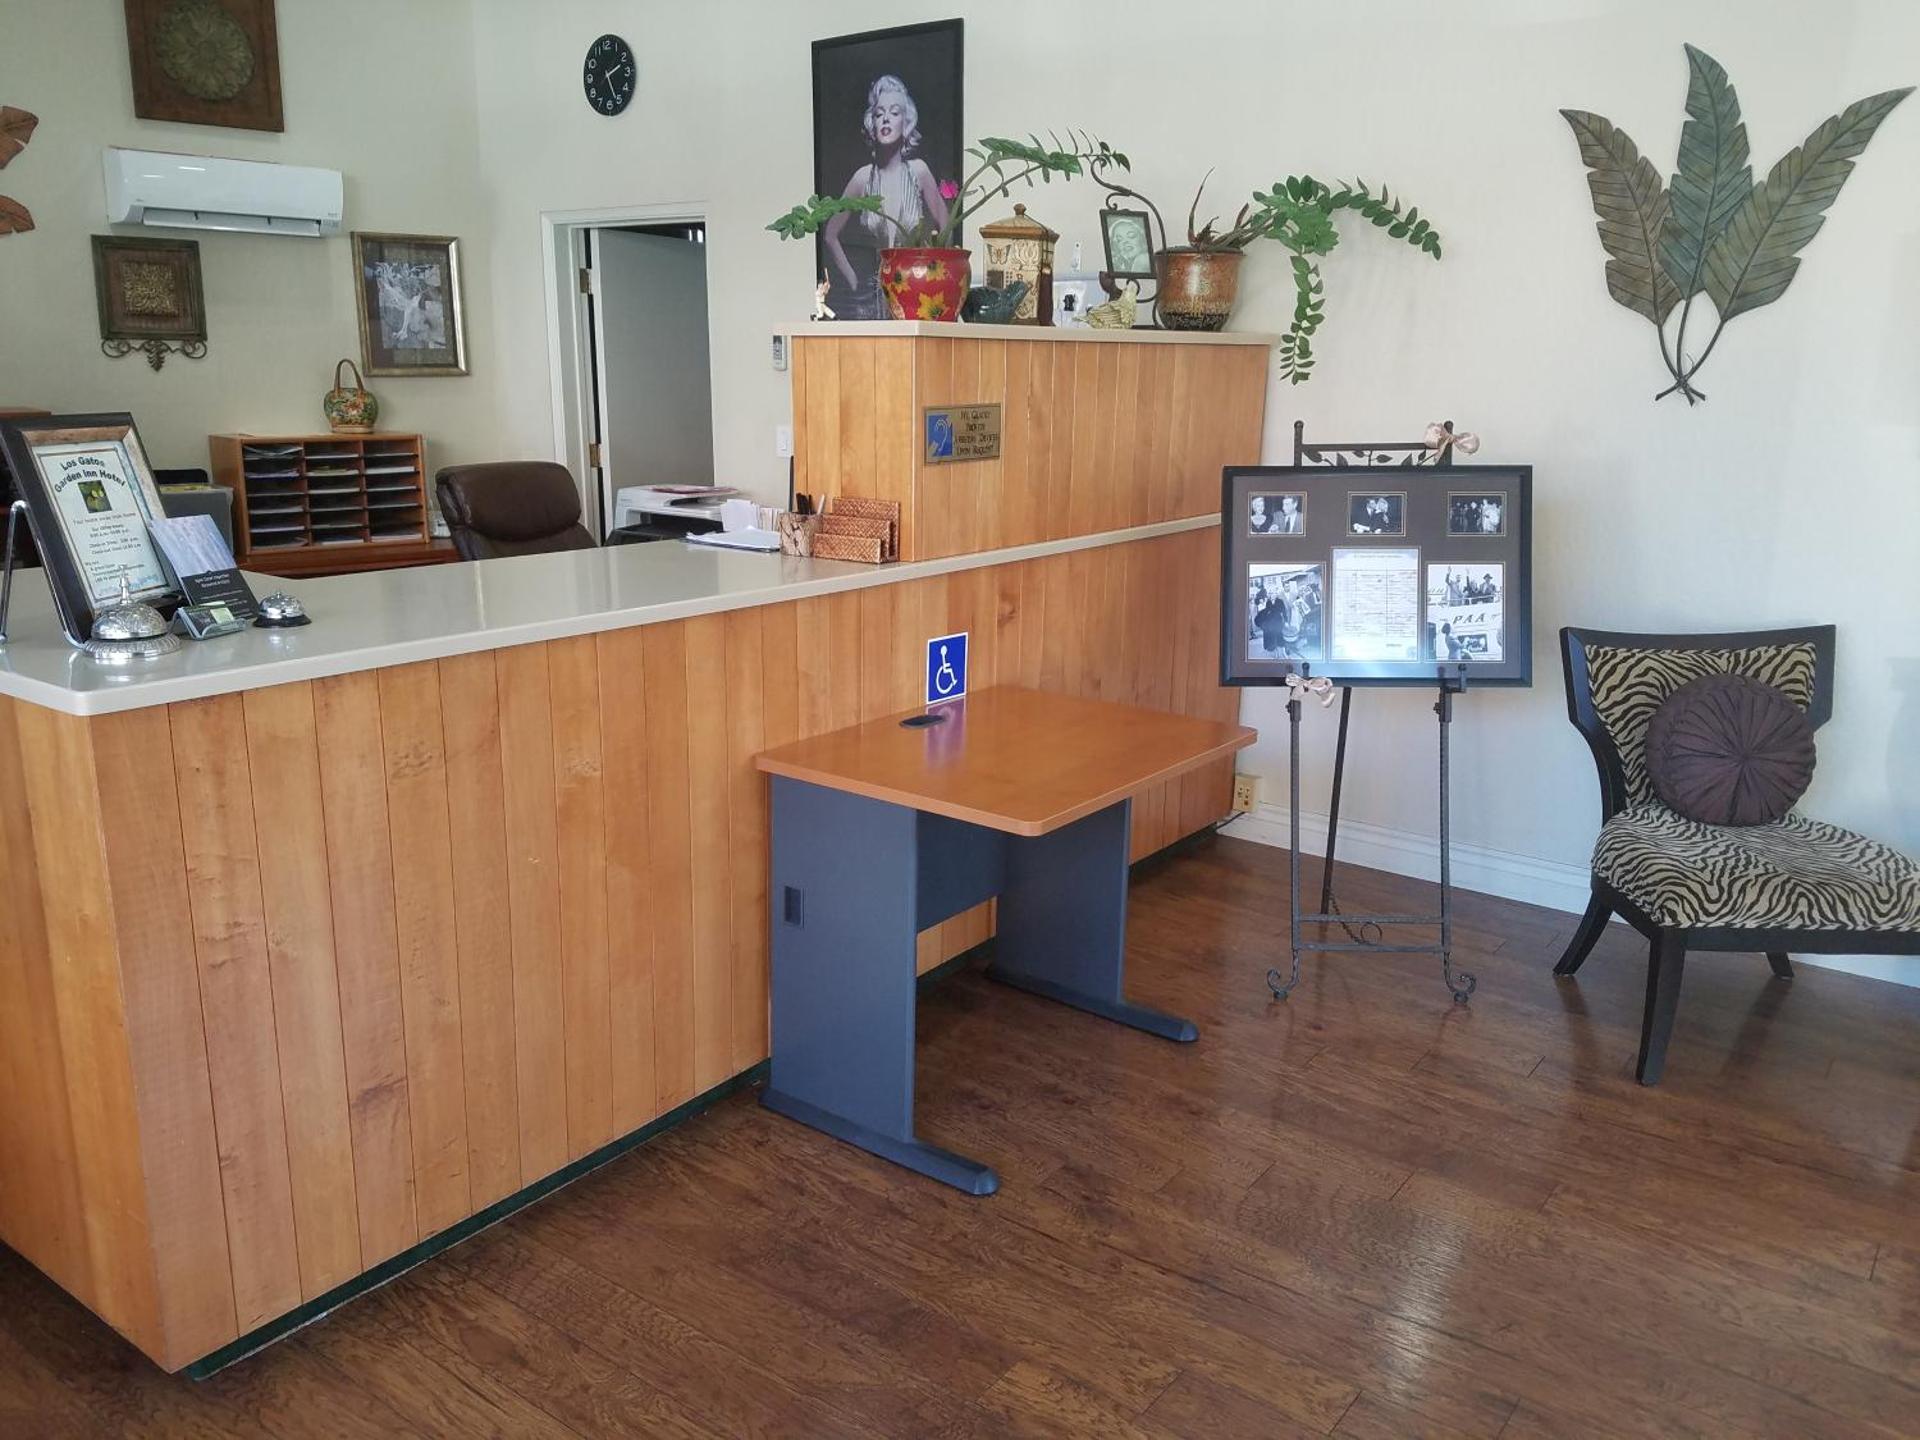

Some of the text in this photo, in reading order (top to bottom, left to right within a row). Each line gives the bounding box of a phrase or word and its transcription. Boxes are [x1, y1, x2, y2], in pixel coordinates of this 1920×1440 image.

[602, 40, 611, 50] 12
[594, 46, 601, 57] 11
[621, 52, 627, 62] 2
[588, 58, 597, 69] 10
[624, 66, 631, 77] 3
[587, 74, 593, 84] 9
[622, 82, 629, 91] 4
[590, 87, 596, 98] 8
[597, 97, 603, 109] 7
[606, 100, 614, 110] 6
[616, 94, 622, 105] 5
[61, 456, 105, 471] Los Gatos
[54, 469, 127, 493] Garden Inn Hotel
